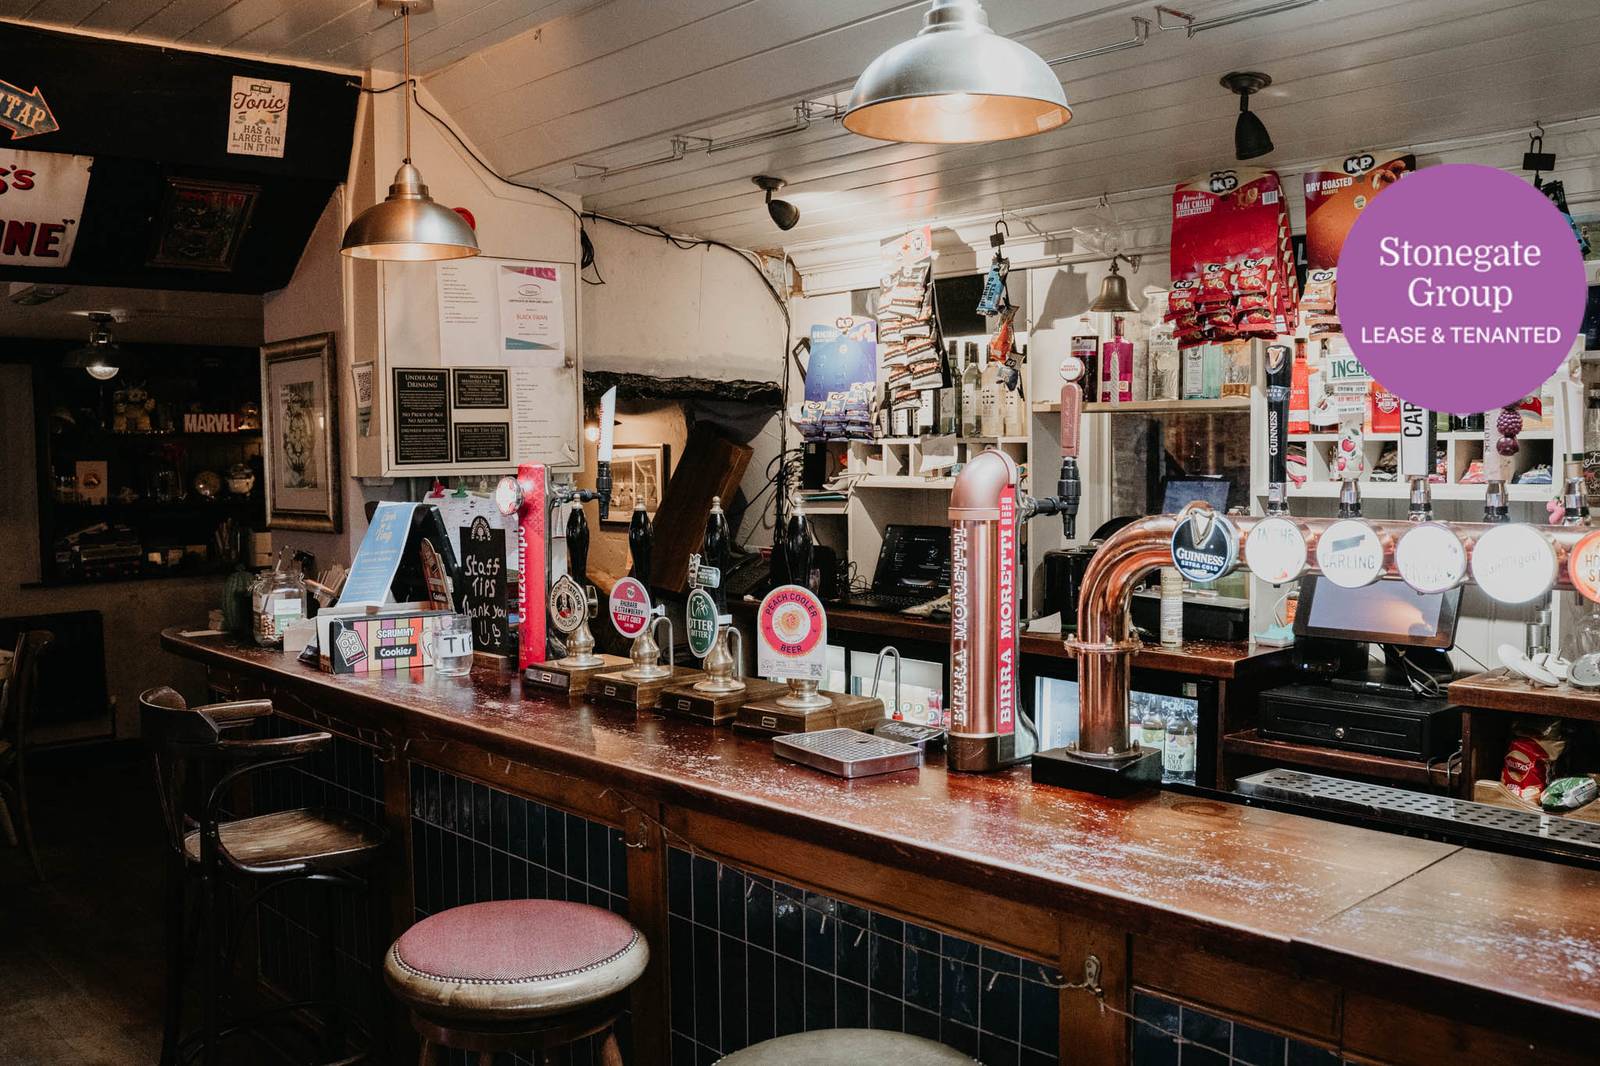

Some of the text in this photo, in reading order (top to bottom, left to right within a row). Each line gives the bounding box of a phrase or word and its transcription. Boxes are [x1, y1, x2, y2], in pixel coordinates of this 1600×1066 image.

[233, 92, 286, 113] Tonic
[3, 94, 46, 129] TAP
[244, 125, 271, 135] HAS A
[233, 133, 280, 145] LARGE GIN
[244, 143, 268, 152] IN IT!
[1346, 156, 1373, 172] KP
[1211, 177, 1236, 192] KP
[1306, 177, 1353, 193] DRY ROASTED
[1176, 201, 1190, 211] THAI
[1314, 272, 1333, 281] KP
[184, 413, 239, 433] MARVEL
[1270, 411, 1278, 456] GUINNESS
[1176, 547, 1226, 567] GUINNESS
[1322, 553, 1376, 570] CARLING
[465, 554, 500, 577] Staff
[1181, 560, 1219, 572] EXTRA COLD
[519, 527, 528, 624] cruzcampo
[1001, 529, 1012, 640] MORETTI
[617, 606, 643, 615] STRAWBERRY
[766, 592, 818, 617] PEACH COOLER
[688, 619, 713, 631] OTTER
[953, 523, 968, 727] BIRRA MORETTI
[377, 627, 415, 639] SCRUMMY
[690, 630, 708, 638] BITTER
[341, 636, 355, 648] OH
[780, 644, 802, 654] BEER
[345, 644, 359, 657] SO
[380, 646, 412, 657] Cookies
[1001, 648, 1012, 724] BIRRA
